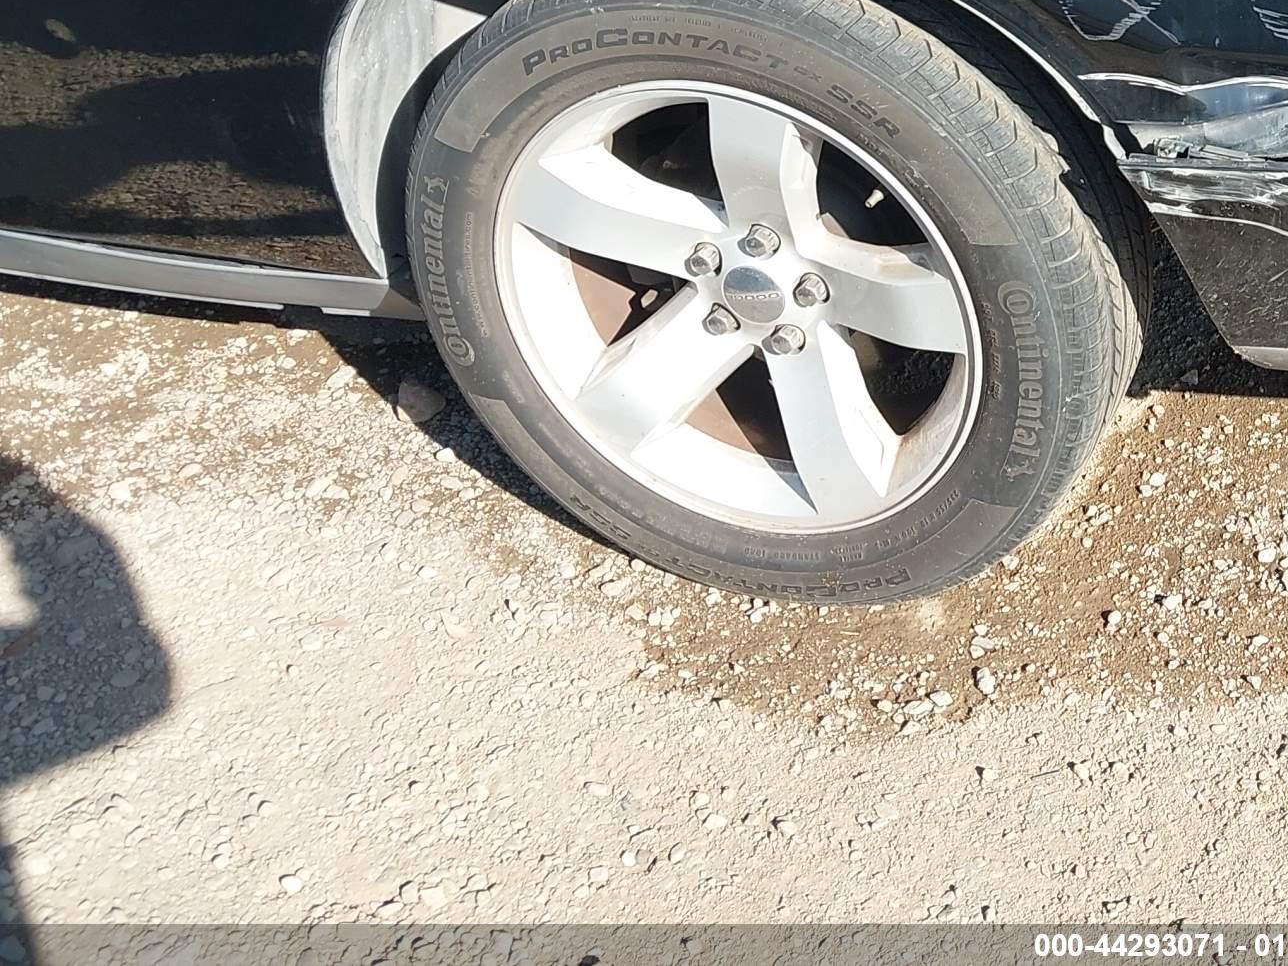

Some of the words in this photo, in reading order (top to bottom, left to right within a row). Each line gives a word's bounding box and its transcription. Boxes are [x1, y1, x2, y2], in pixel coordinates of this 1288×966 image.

[826, 83, 901, 140] SSR
[420, 192, 476, 367] Continental
[997, 280, 1049, 459] Continental
